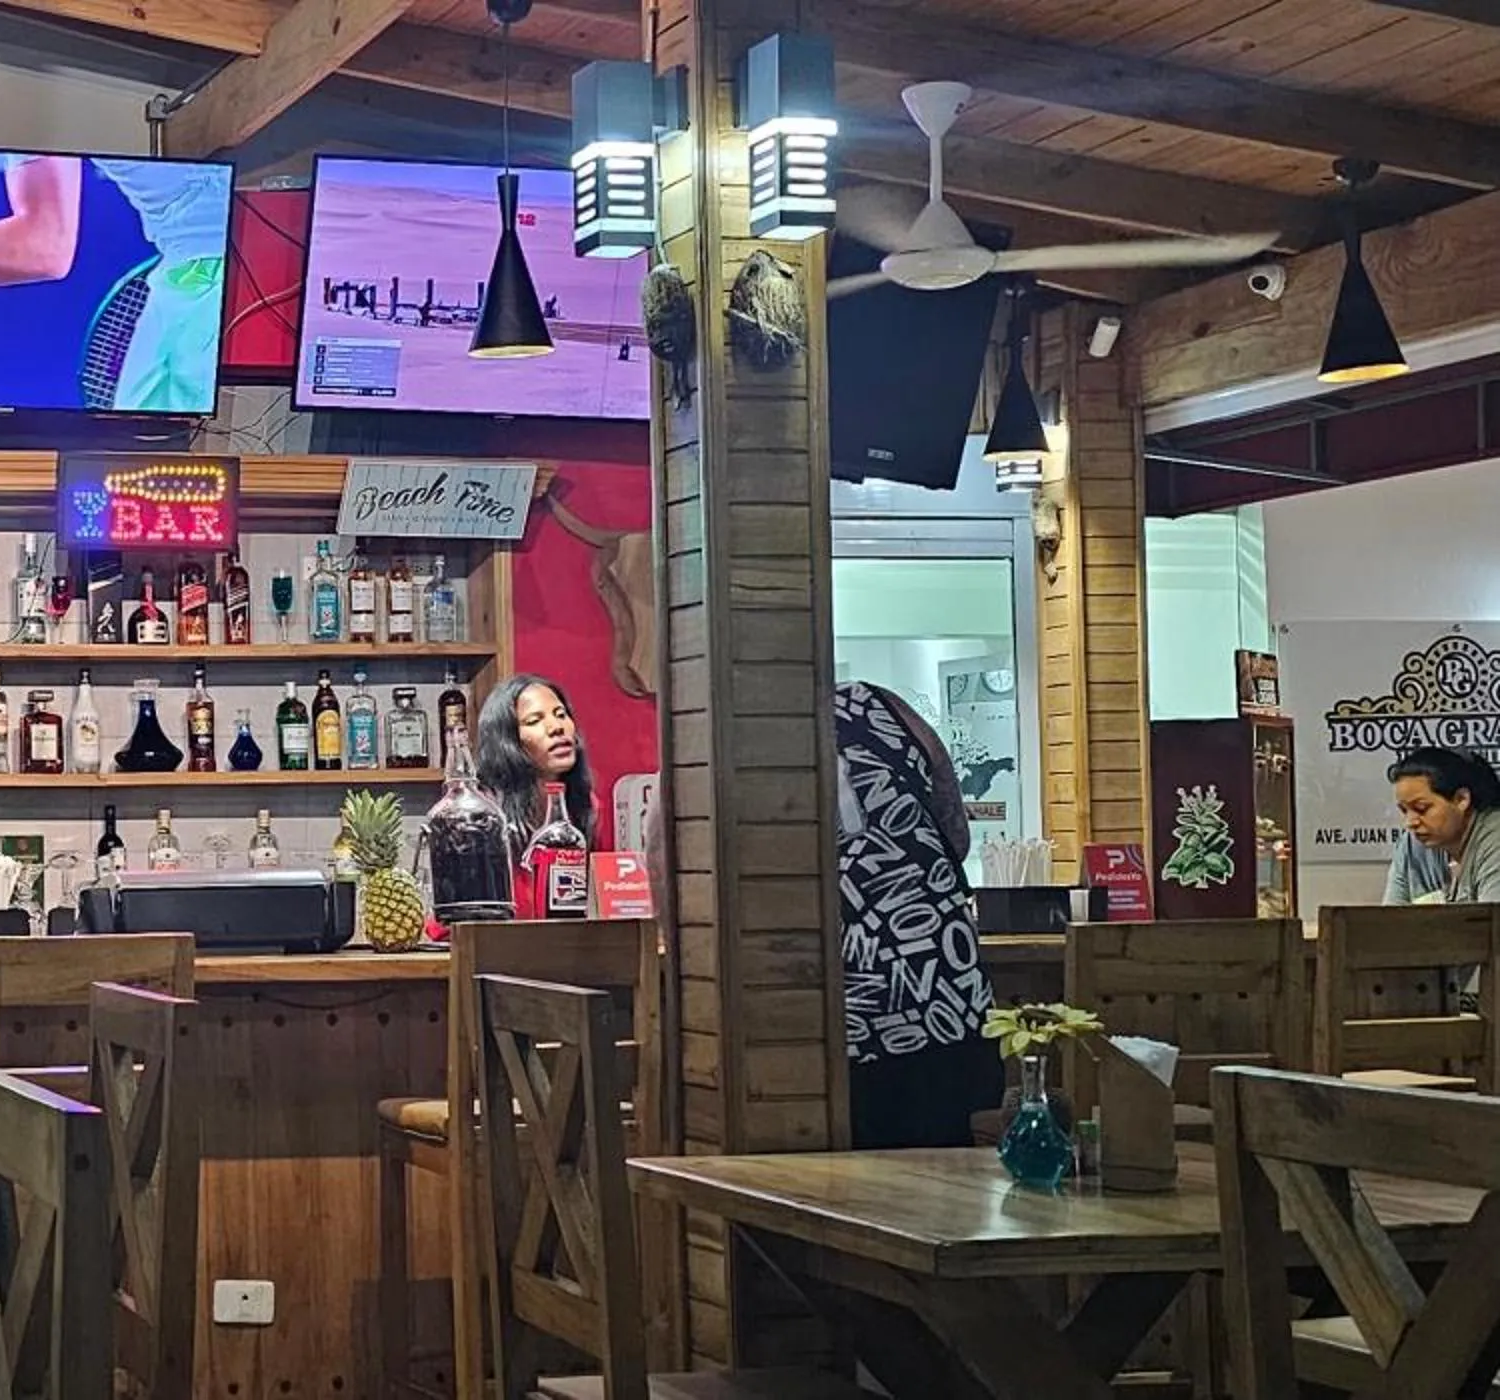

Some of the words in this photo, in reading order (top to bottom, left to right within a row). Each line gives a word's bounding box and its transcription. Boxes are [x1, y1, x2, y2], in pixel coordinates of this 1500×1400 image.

[355, 472, 448, 521] Beach
[454, 480, 516, 523] Time
[110, 498, 224, 541] BAR
[1315, 828, 1347, 844] AVE.
[1350, 828, 1387, 843] JUAN
